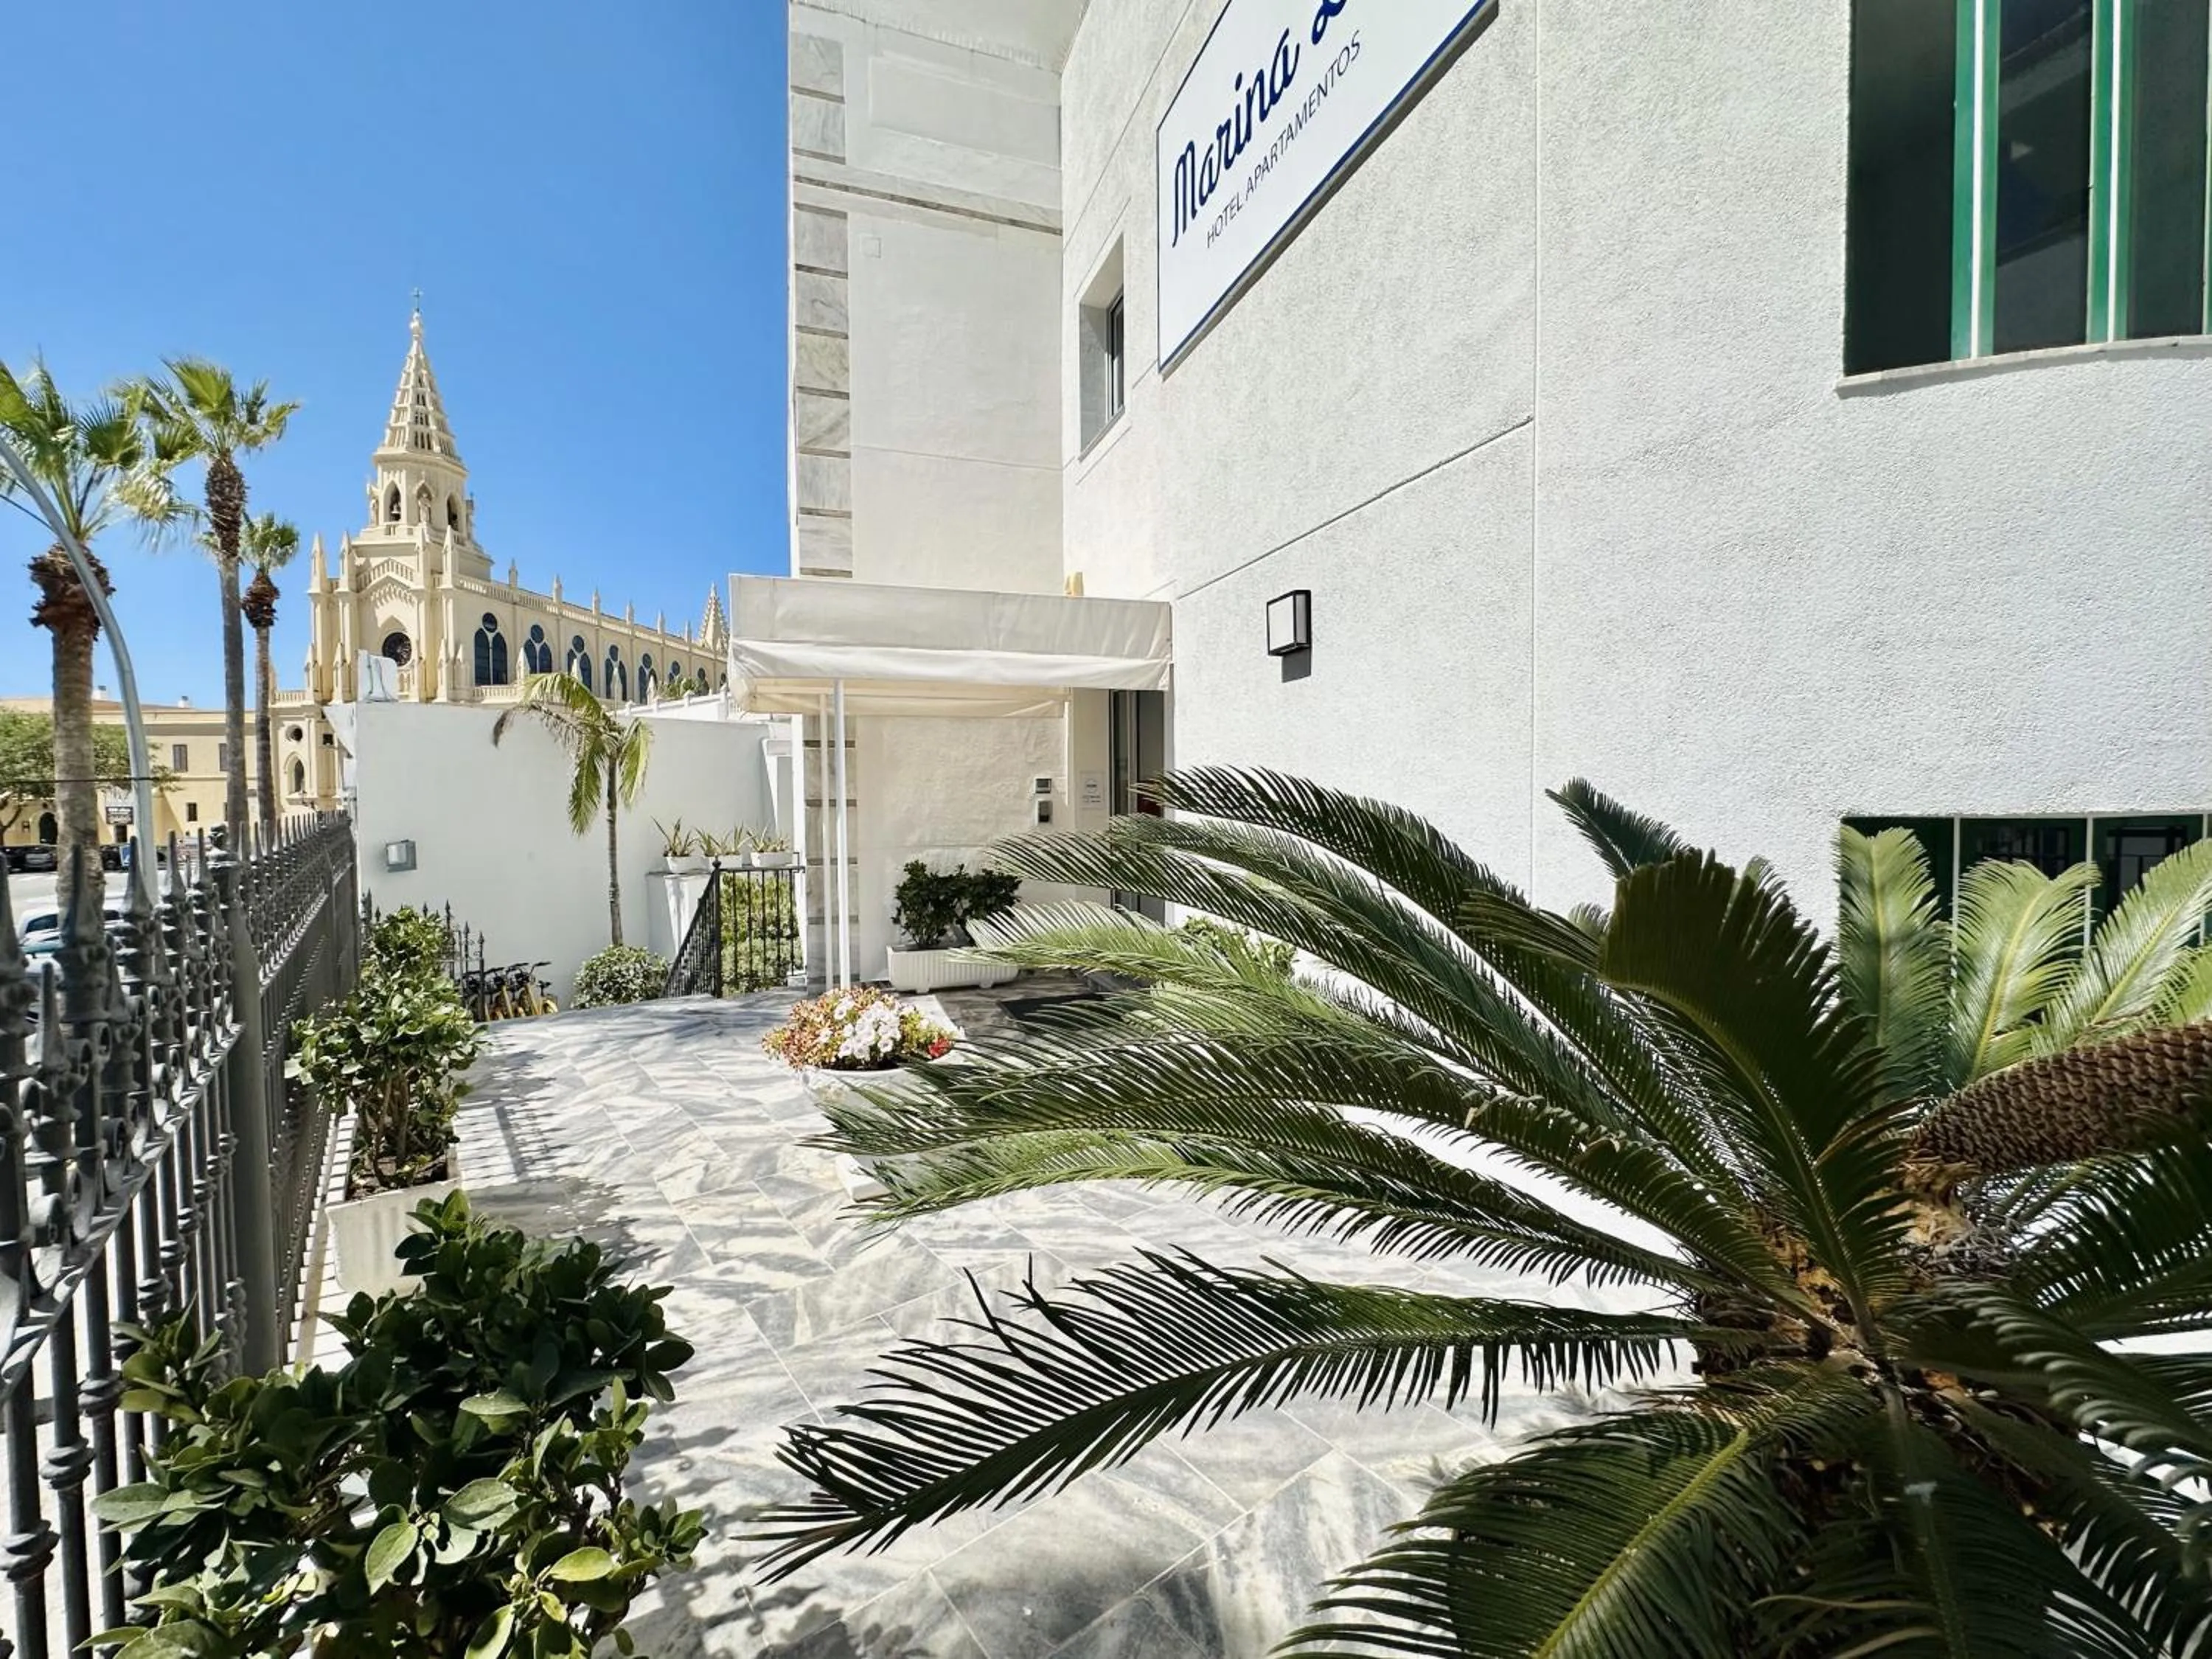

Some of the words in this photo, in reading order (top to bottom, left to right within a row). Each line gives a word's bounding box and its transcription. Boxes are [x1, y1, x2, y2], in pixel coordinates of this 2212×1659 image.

[1172, 27, 1300, 248] Marina
[1207, 192, 1243, 248] HOTEL
[1246, 29, 1360, 201] APARTAMENTOS
